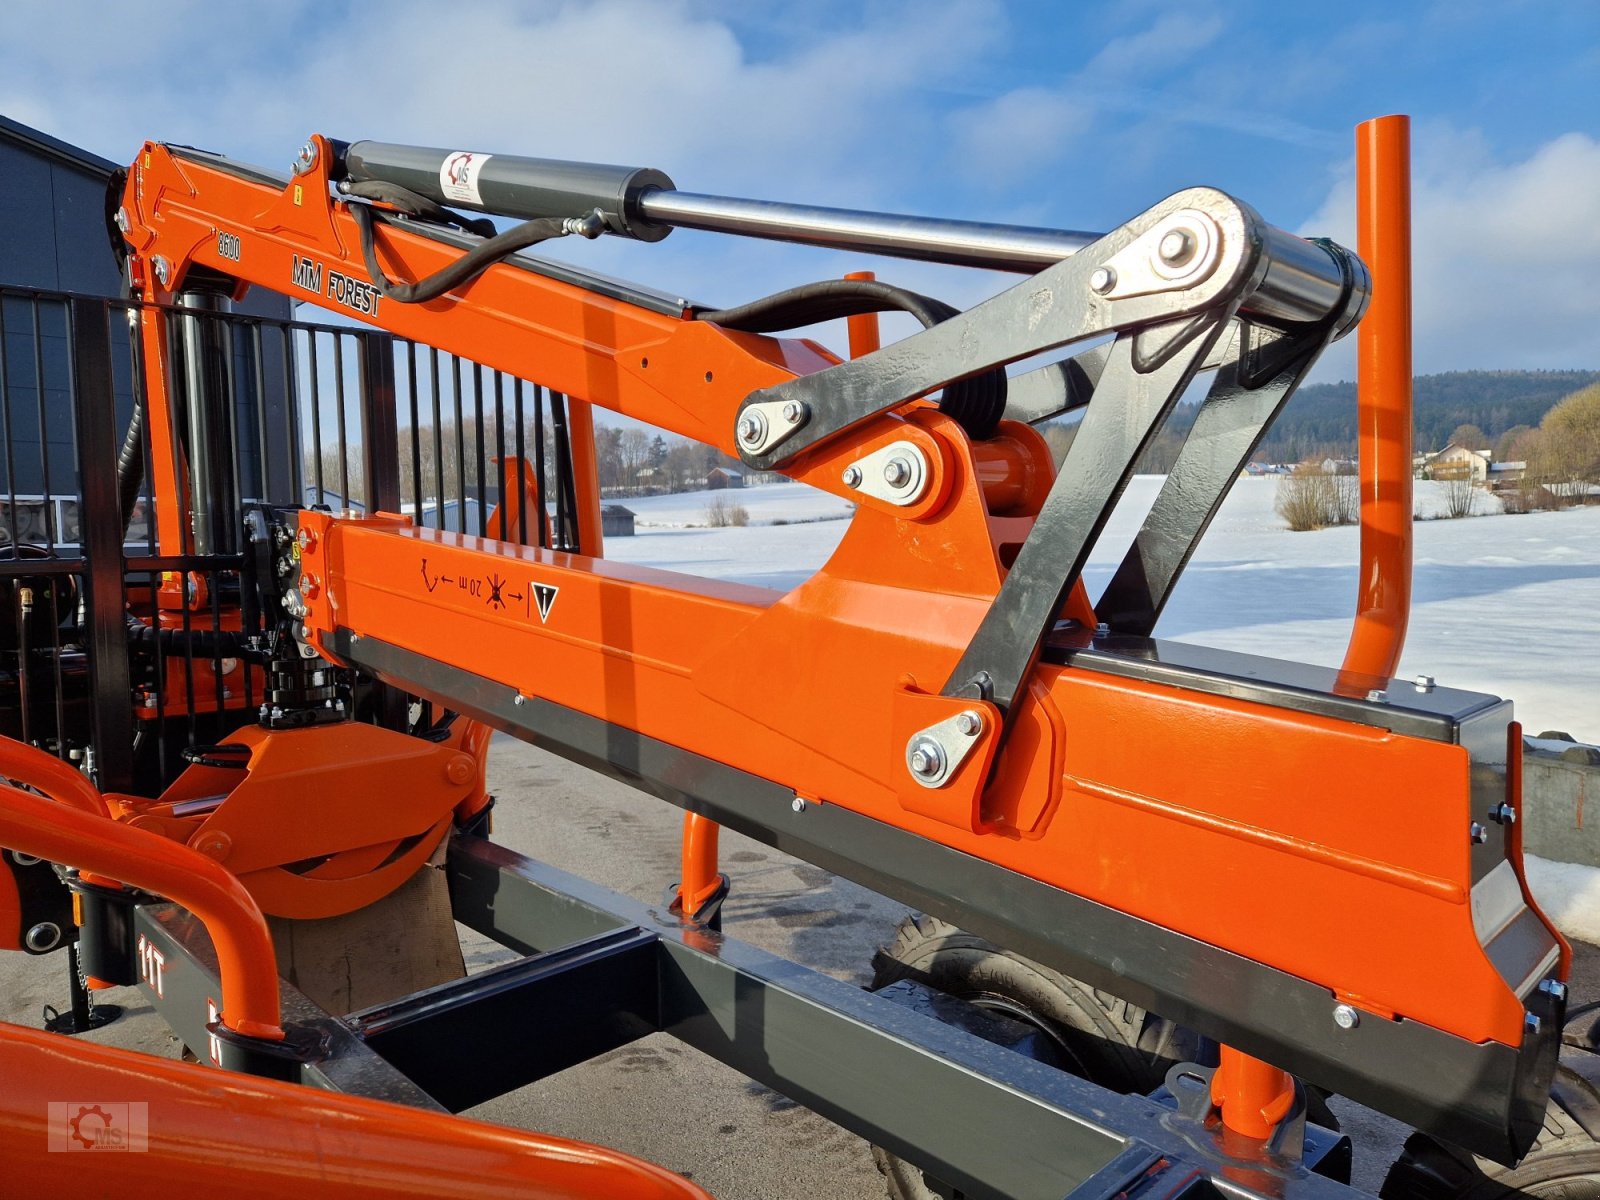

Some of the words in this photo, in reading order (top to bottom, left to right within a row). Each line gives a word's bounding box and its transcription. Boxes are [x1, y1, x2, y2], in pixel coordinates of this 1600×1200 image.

[218, 231, 240, 261] 8600
[291, 254, 322, 294] MTM
[327, 270, 383, 318] FOREST
[470, 578, 481, 597] 20
[138, 932, 164, 1000] 11T
